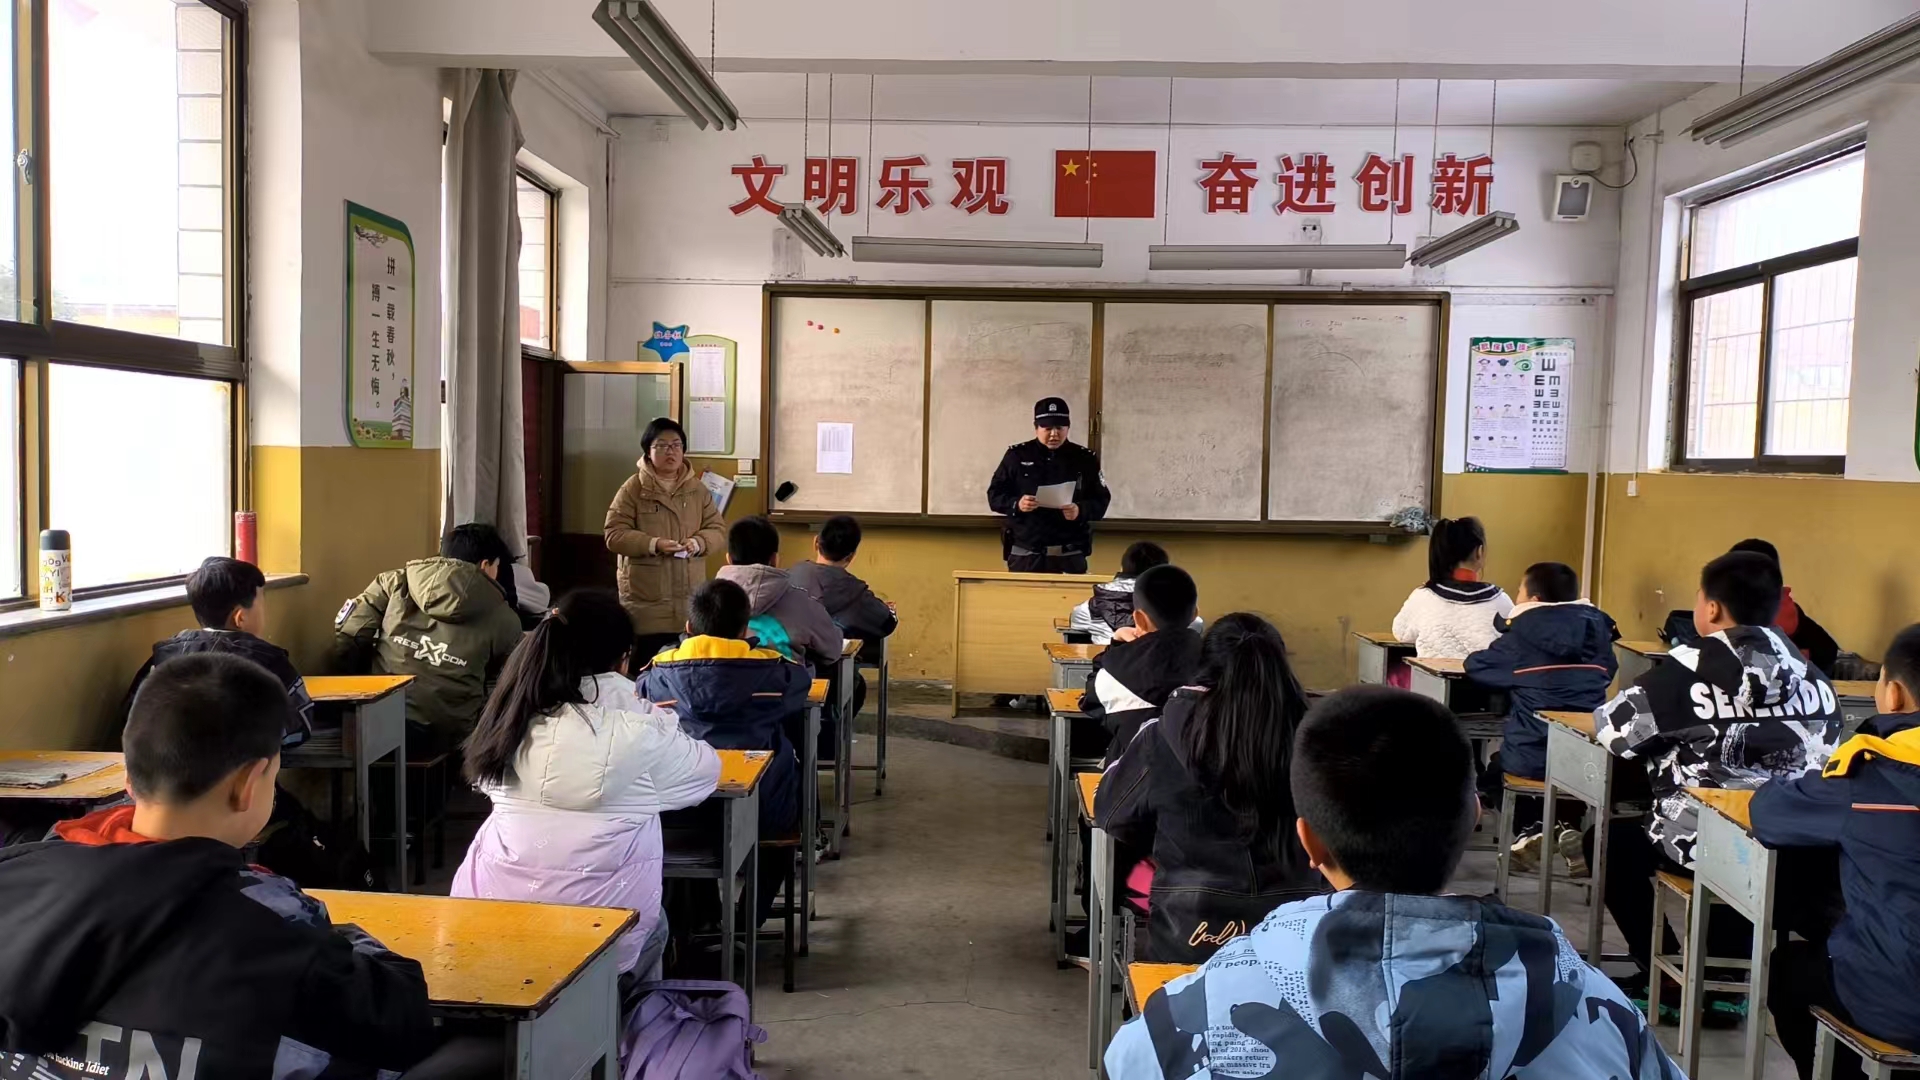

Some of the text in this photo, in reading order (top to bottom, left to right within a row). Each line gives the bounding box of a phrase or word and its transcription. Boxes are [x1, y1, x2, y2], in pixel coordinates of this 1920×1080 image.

[731, 153, 1010, 216] 文明乐观
[1199, 153, 1494, 215] 奋进创新
[1225, 959, 1261, 969] peop
